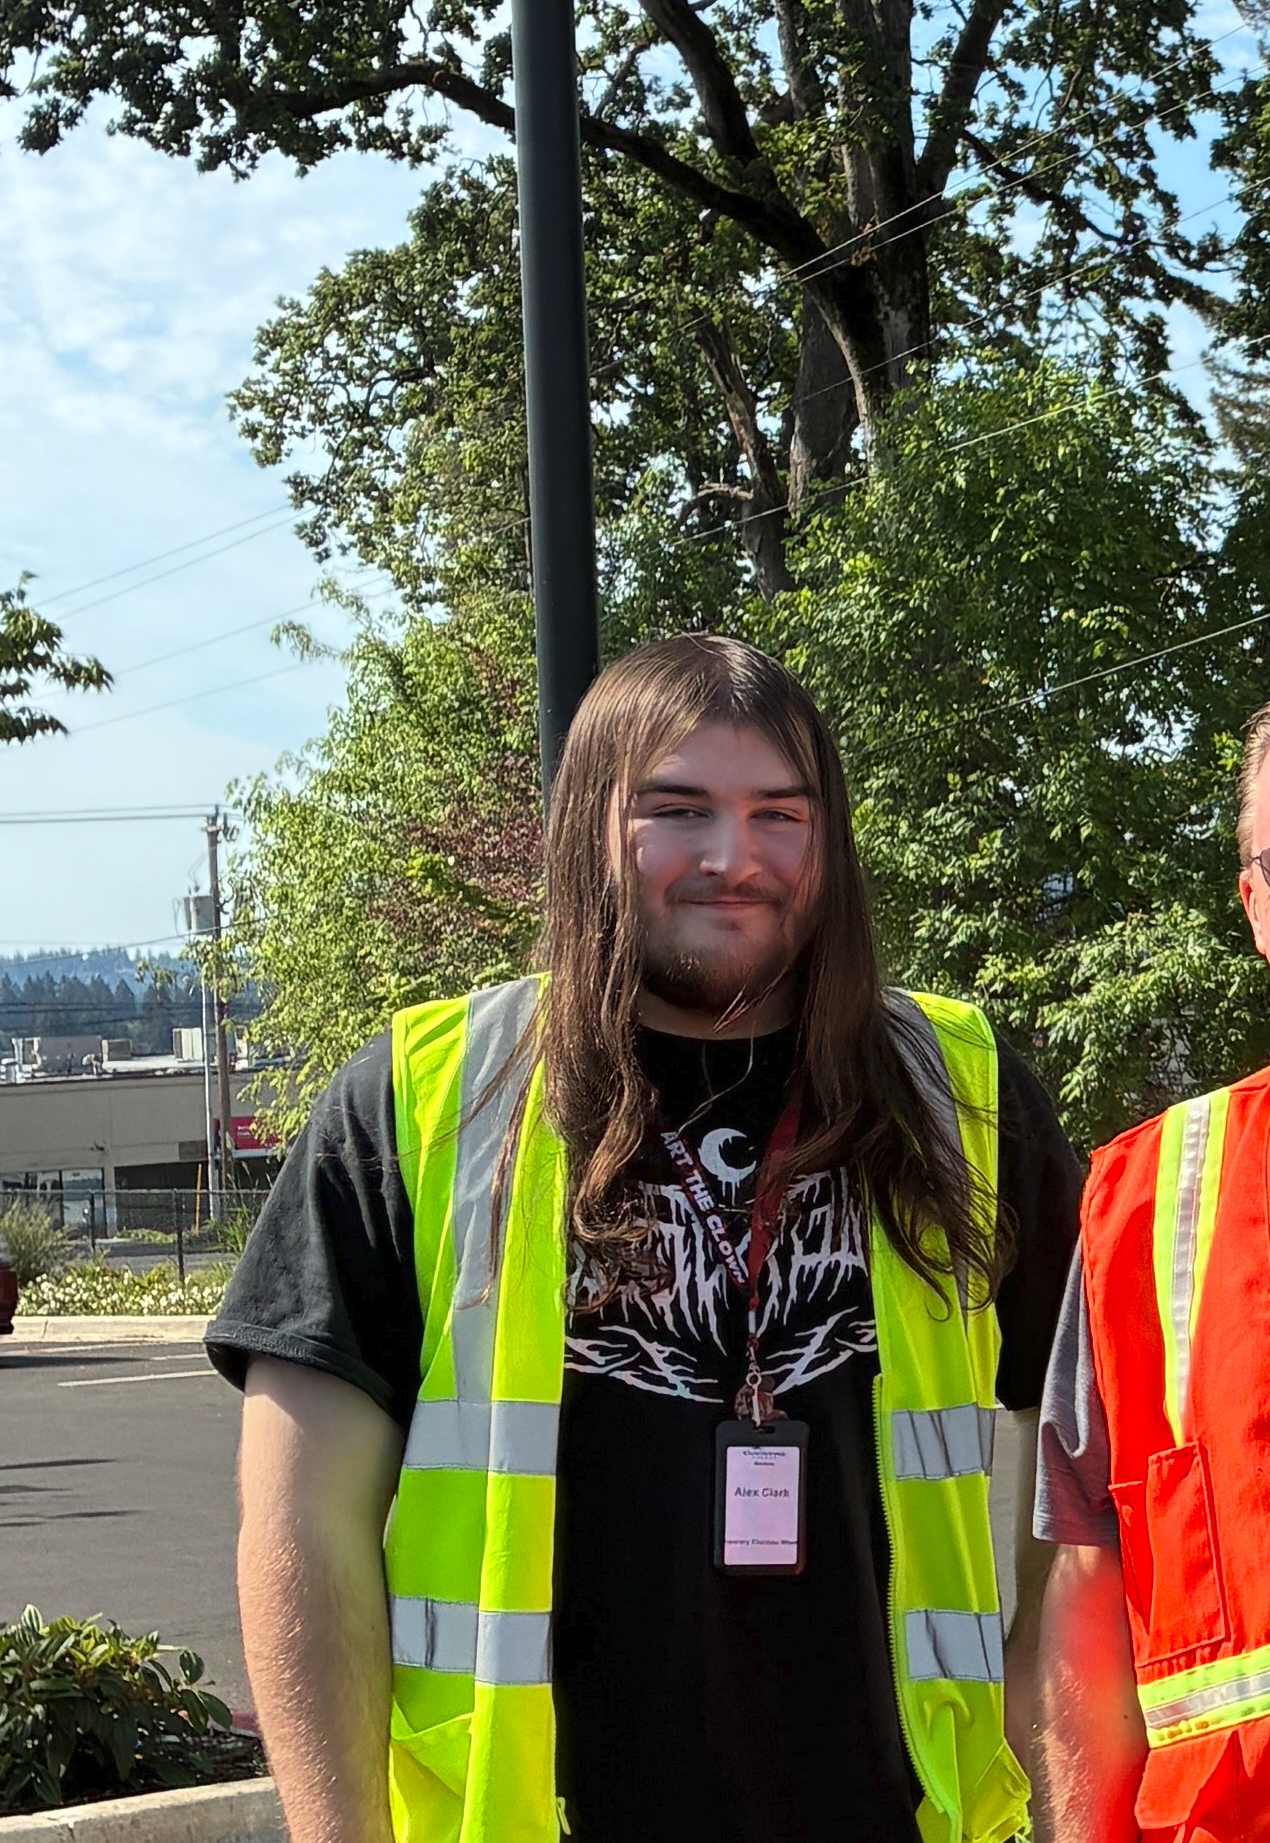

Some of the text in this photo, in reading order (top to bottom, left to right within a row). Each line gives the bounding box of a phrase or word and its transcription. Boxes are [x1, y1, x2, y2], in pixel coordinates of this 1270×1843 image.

[660, 1131, 747, 1284] ART THE CLOWN
[734, 1487, 759, 1498] Alex
